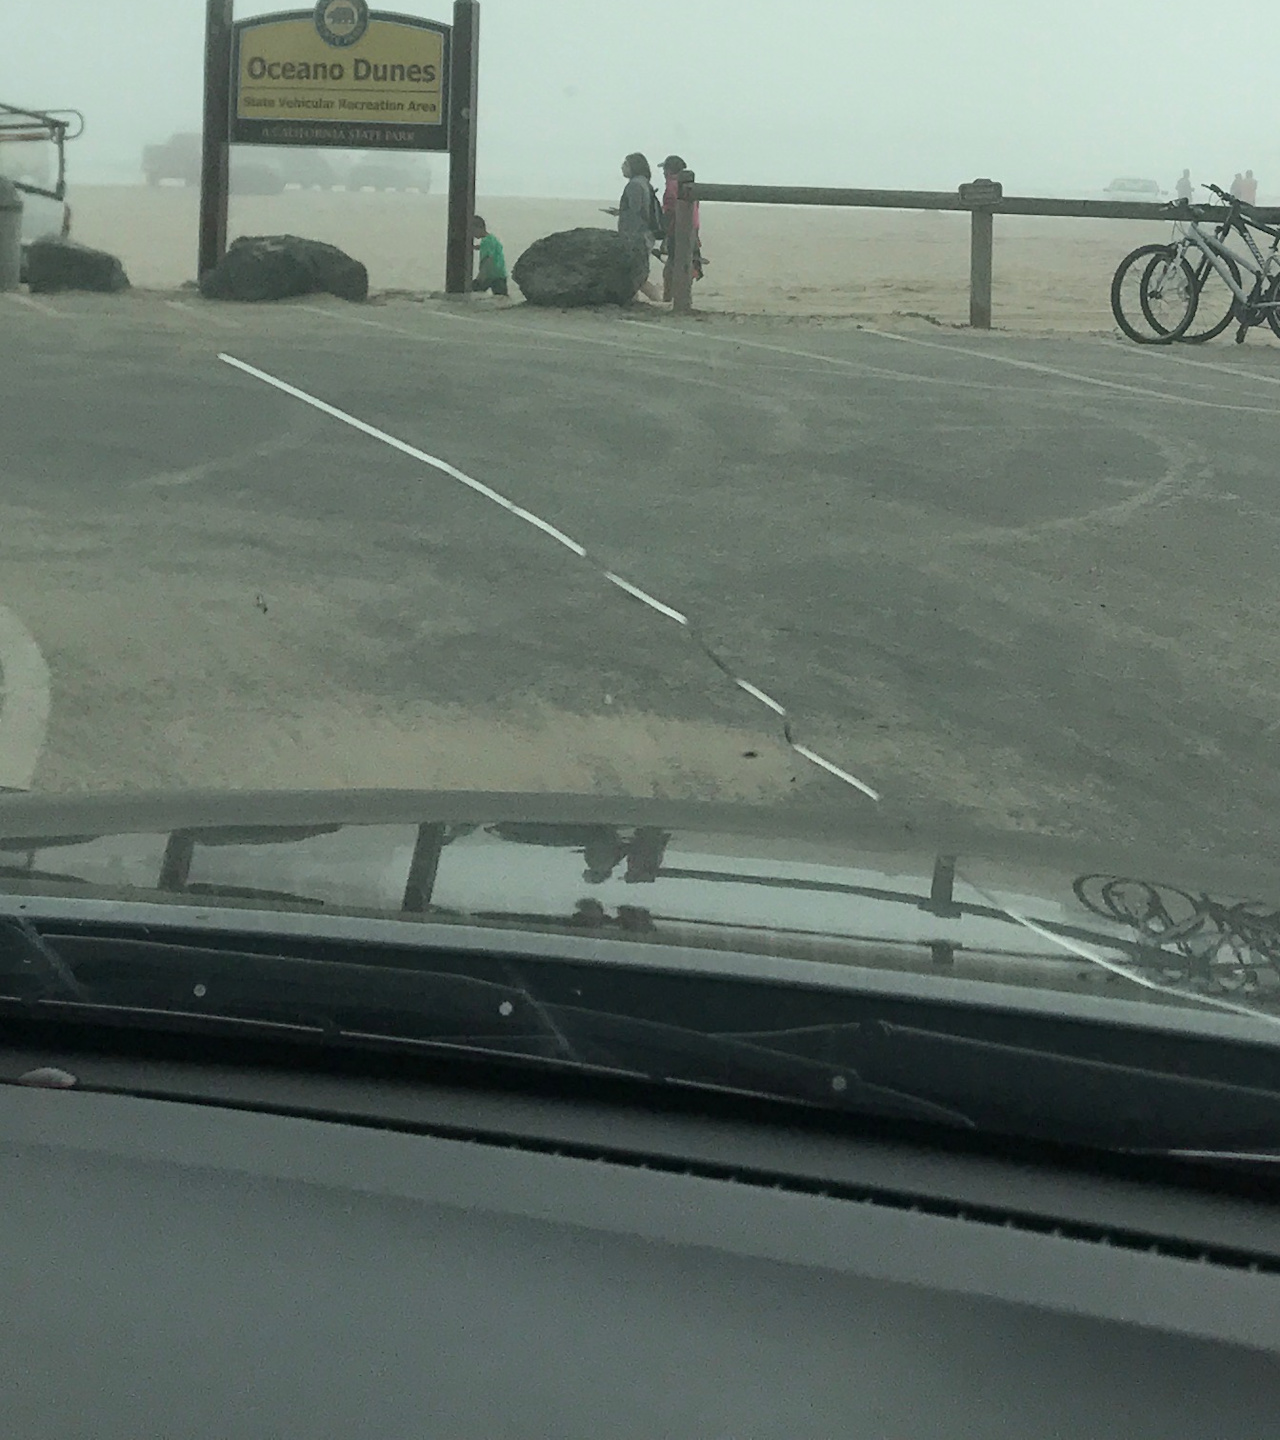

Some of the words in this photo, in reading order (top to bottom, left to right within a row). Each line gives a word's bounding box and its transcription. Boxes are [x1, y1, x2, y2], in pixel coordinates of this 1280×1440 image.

[247, 56, 344, 82] Oceano
[353, 59, 436, 83] Dunes
[243, 96, 275, 108] State
[279, 97, 335, 110] Vehicular
[339, 98, 404, 111] Recreation
[408, 100, 437, 113] Area
[274, 127, 345, 141] CALIFORNIA
[349, 129, 383, 142] STATE
[385, 130, 416, 142] PARK
